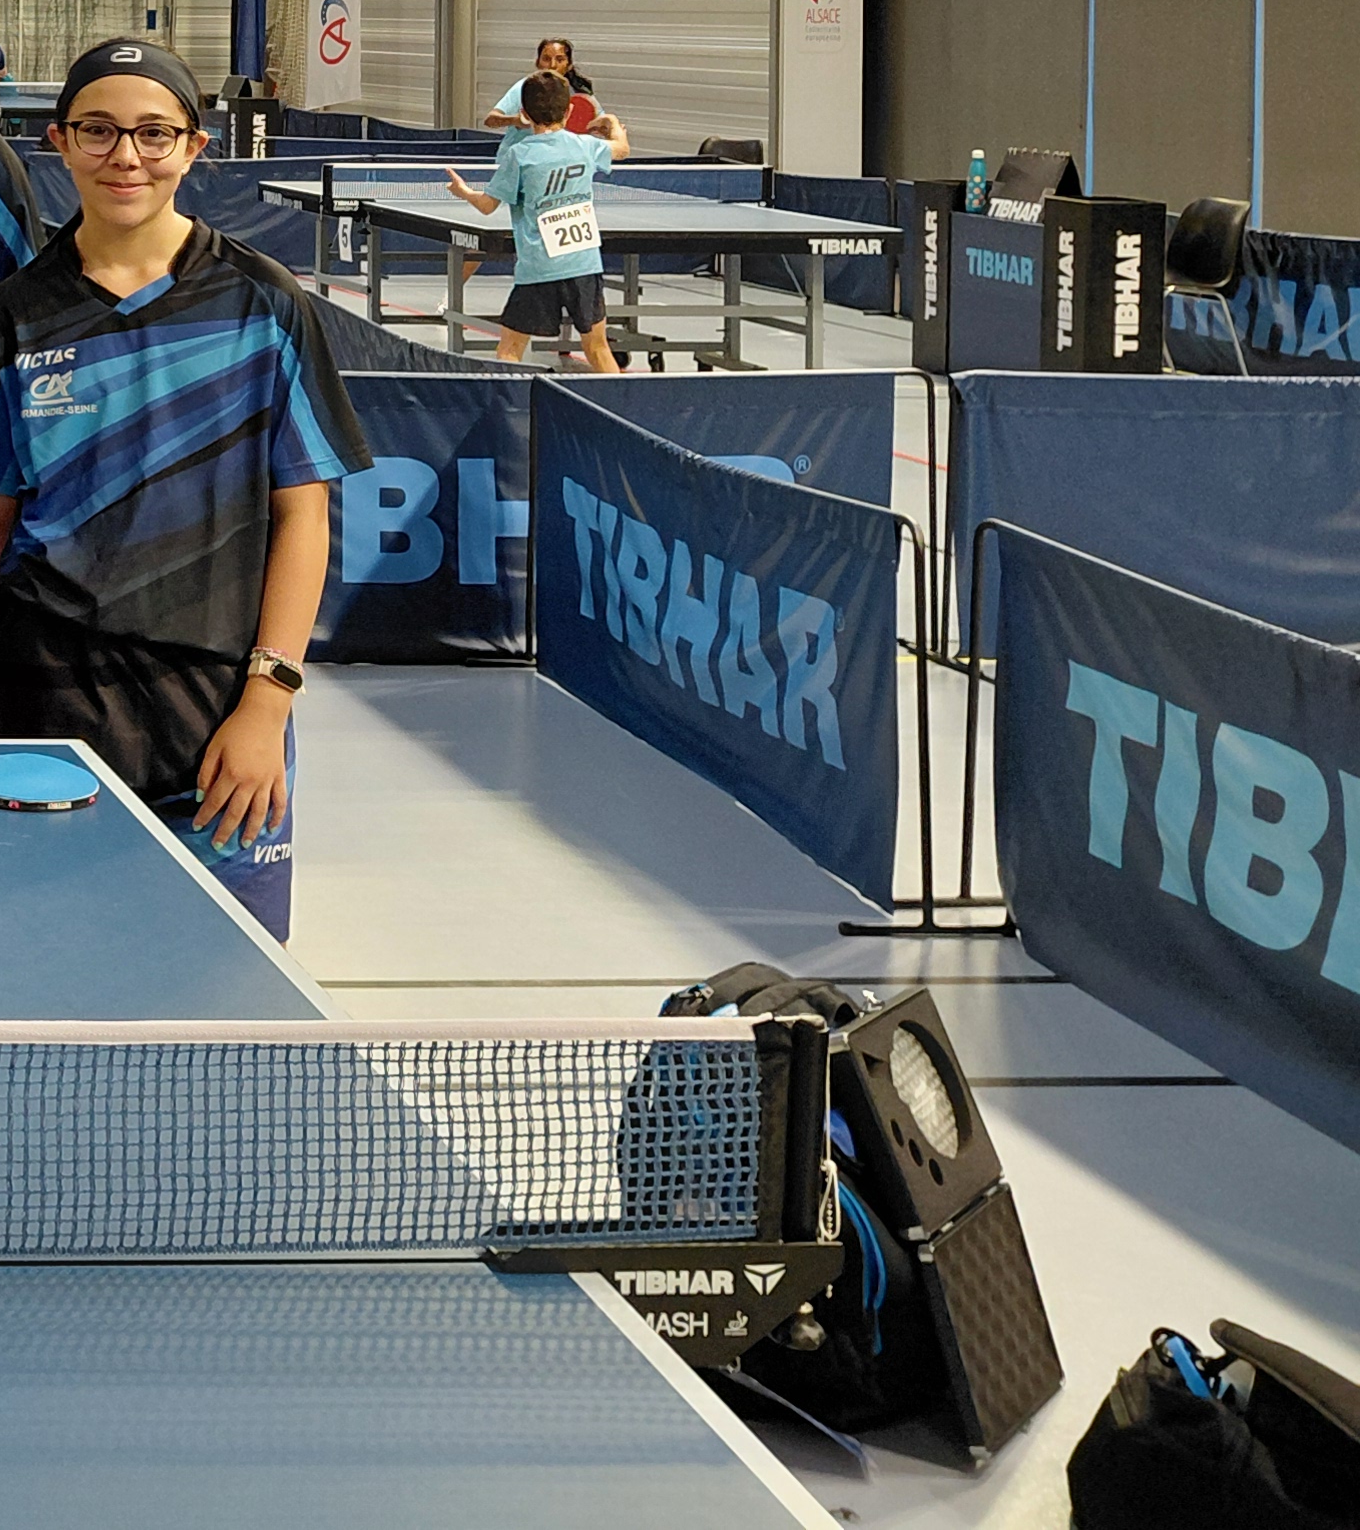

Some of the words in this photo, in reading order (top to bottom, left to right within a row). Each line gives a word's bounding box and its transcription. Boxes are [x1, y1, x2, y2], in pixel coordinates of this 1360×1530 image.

[806, 8, 841, 24] ALSACE
[540, 209, 581, 226] TIBHAR
[986, 197, 1043, 223] TIBHAR
[341, 224, 349, 249] 5
[450, 230, 479, 251] TIBHAR
[554, 222, 593, 247] 203
[808, 238, 882, 256] TIBHAR
[924, 209, 938, 321] TIBHAR
[966, 248, 1034, 286] TIBHAR
[1056, 230, 1075, 352] TIBHAR
[1113, 233, 1142, 358] TIBHAR
[14, 347, 77, 370] VICTAS
[561, 476, 847, 772] TIBHAR
[1065, 659, 1360, 996] TIB
[614, 1269, 734, 1296] TIBHAR
